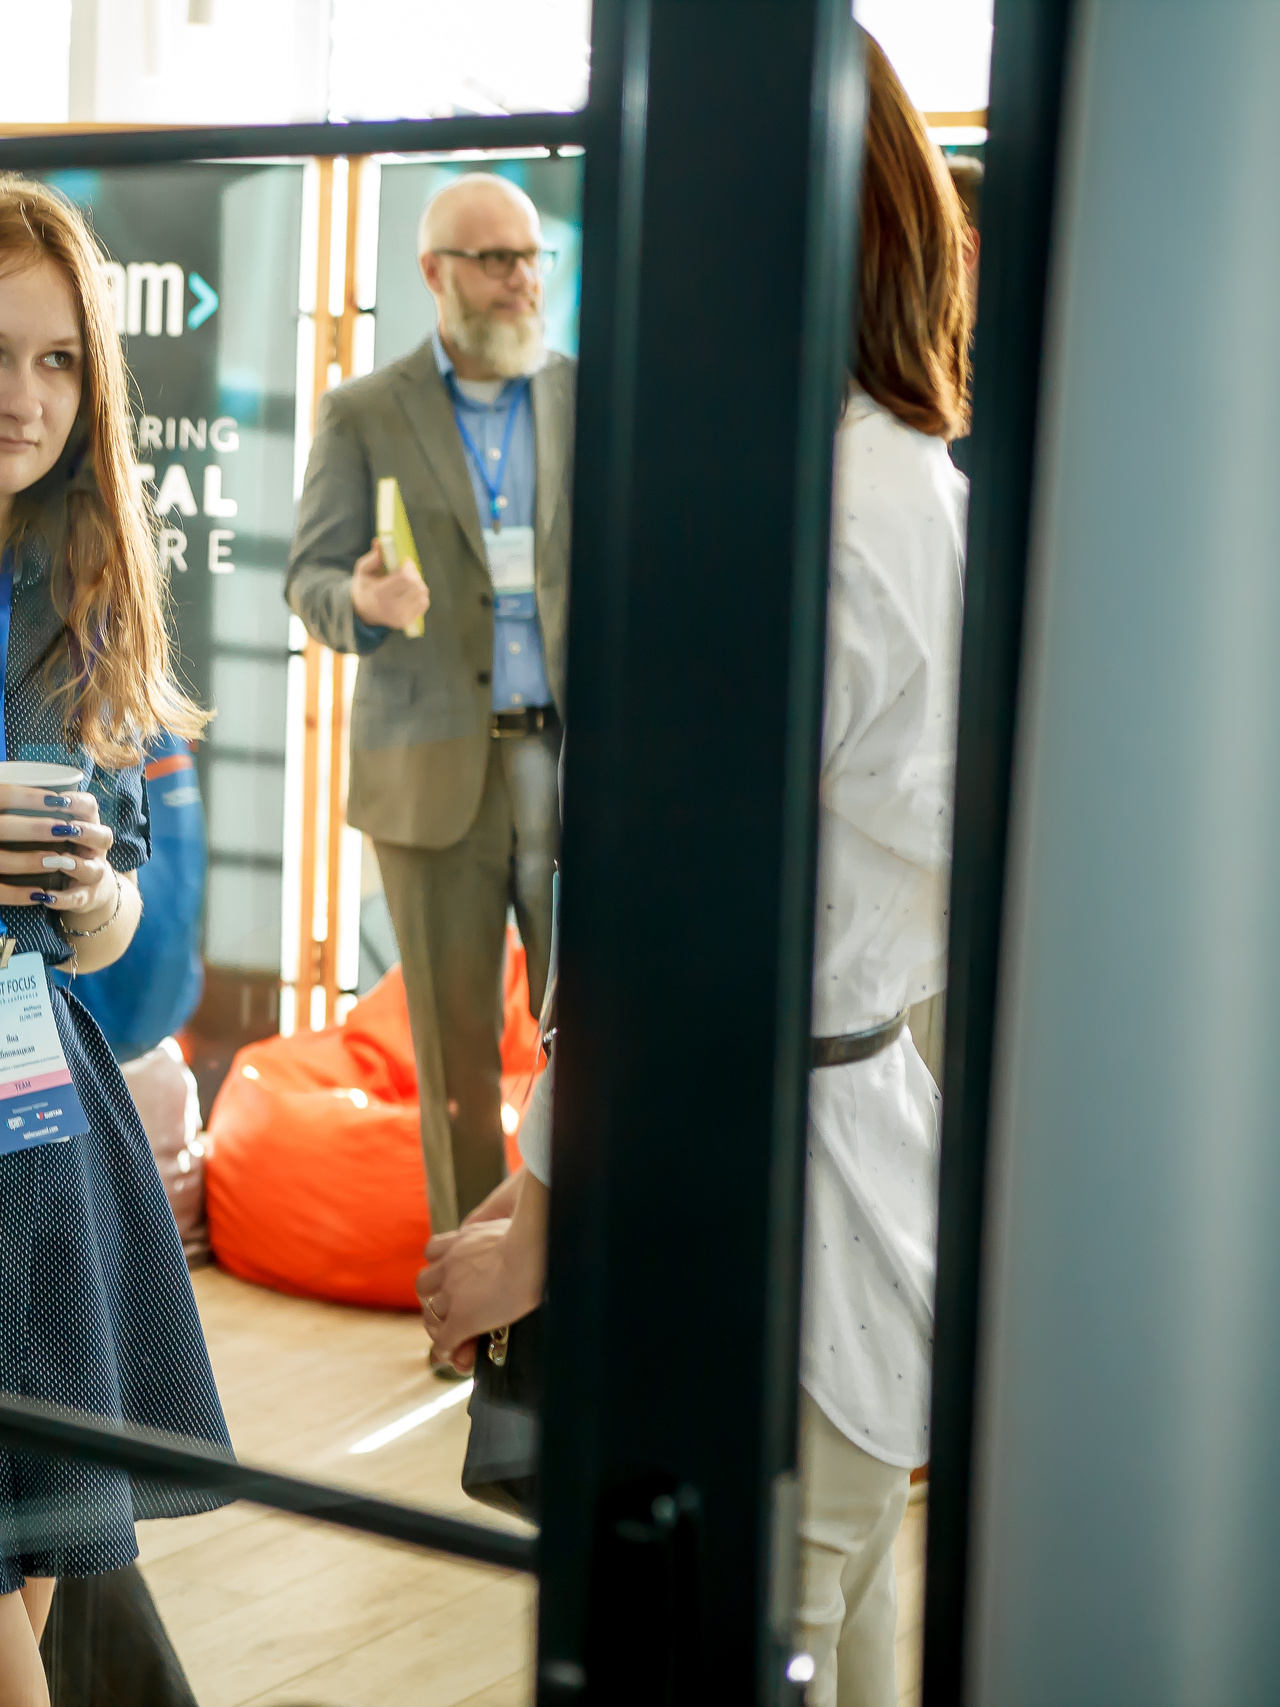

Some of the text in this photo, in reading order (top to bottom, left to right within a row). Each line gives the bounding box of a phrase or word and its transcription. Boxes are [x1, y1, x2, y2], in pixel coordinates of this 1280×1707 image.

[129, 415, 240, 453] RING
[7, 974, 37, 994] FOCUS
[14, 1080, 32, 1092] TEAM
